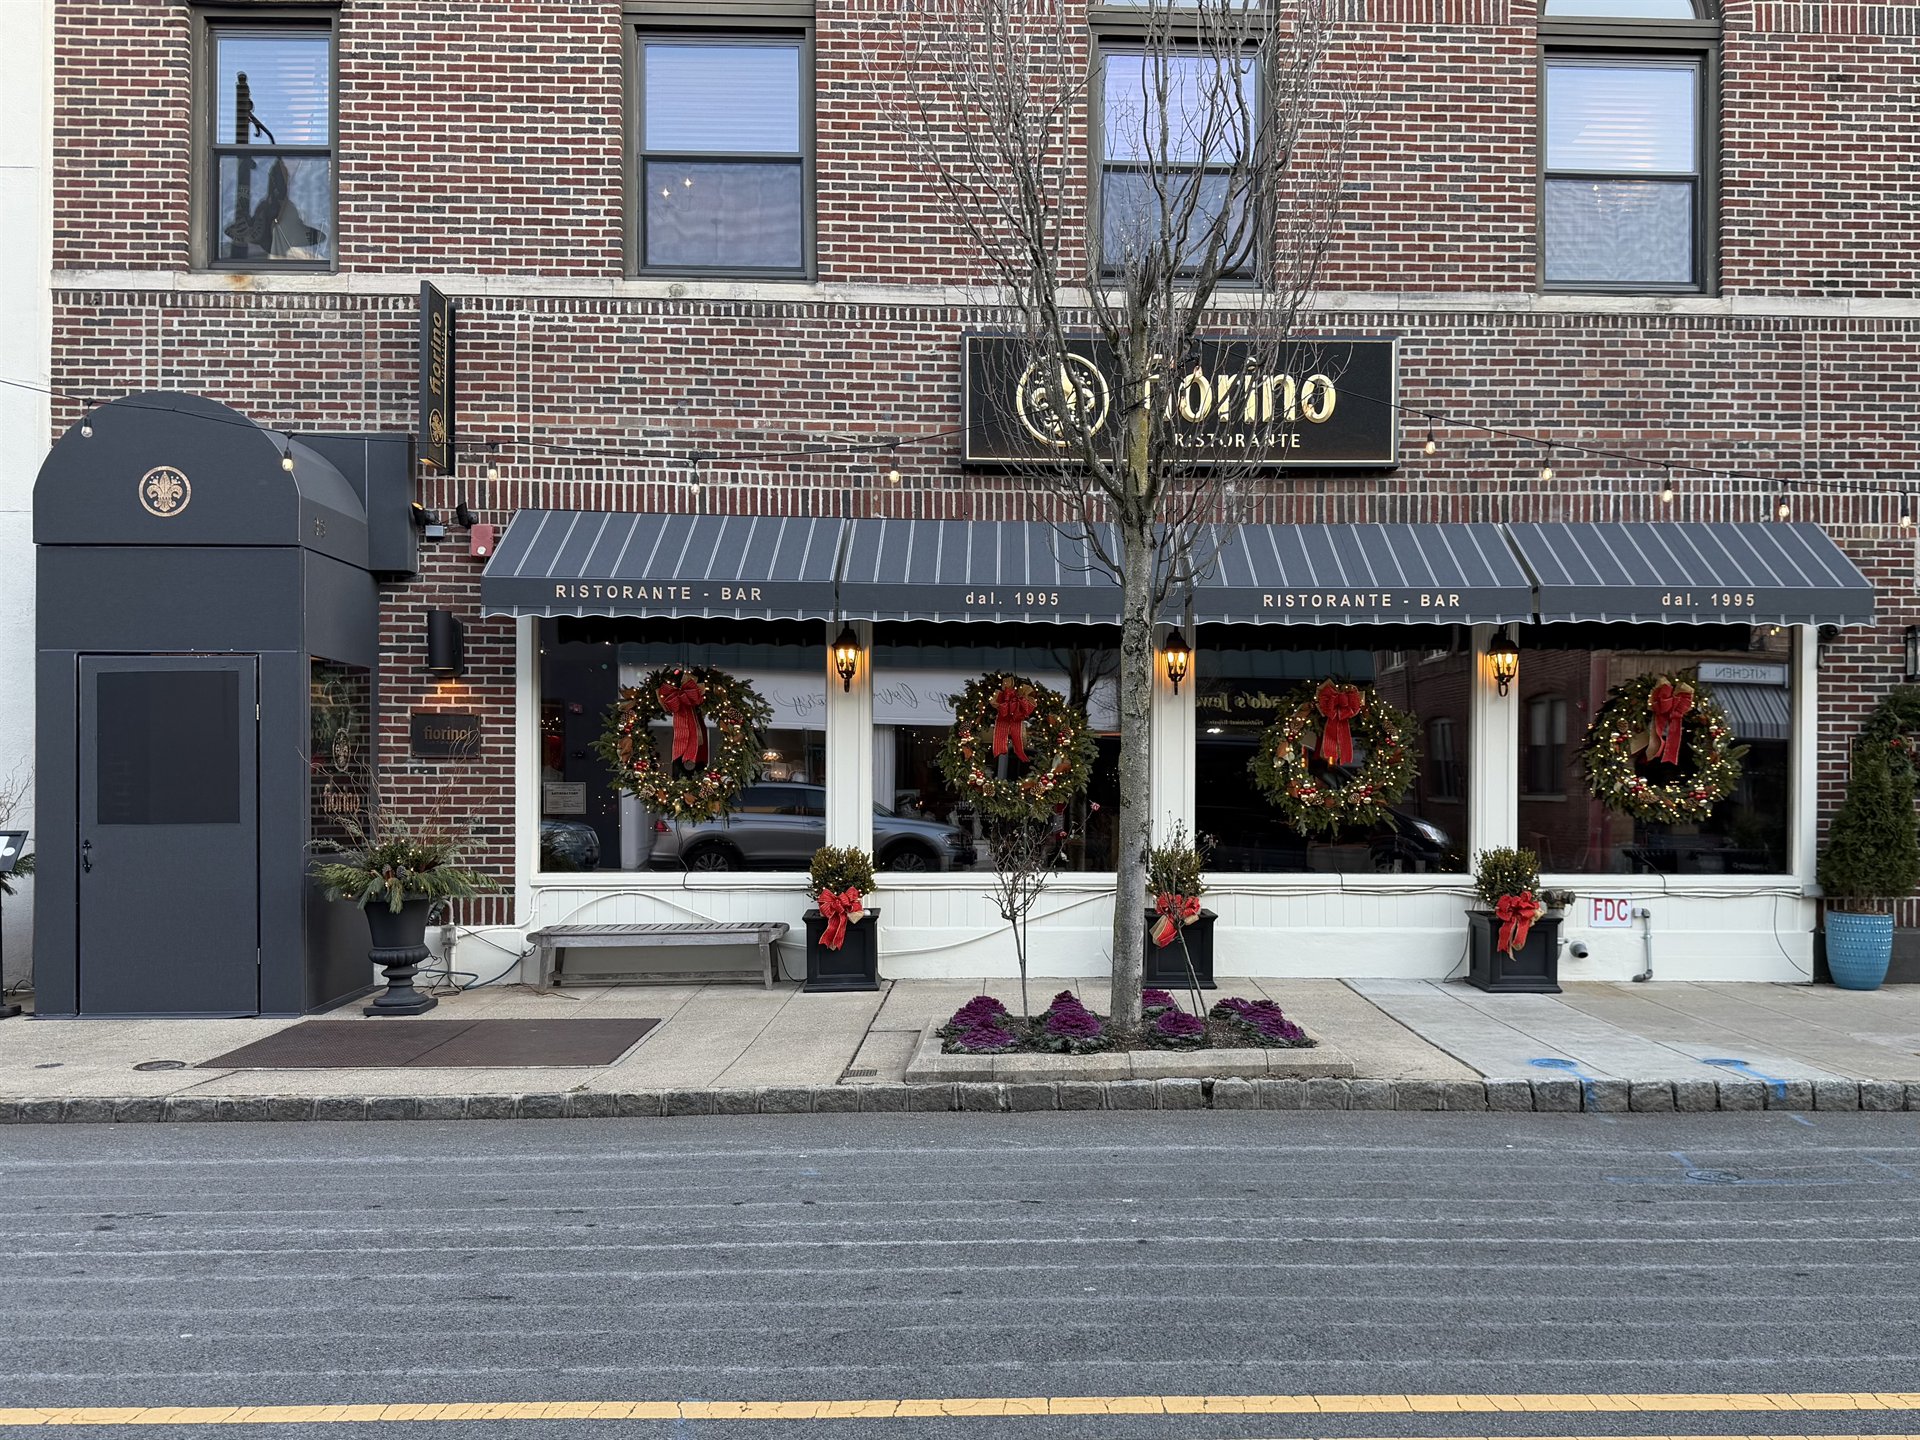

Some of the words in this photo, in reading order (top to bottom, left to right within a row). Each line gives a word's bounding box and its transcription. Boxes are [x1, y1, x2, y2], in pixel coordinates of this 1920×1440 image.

[429, 311, 442, 396] fiorino
[1174, 433, 1300, 448] RISTORANTE
[555, 584, 691, 600] RISTORANTE
[721, 587, 762, 601] BAR
[965, 591, 1003, 606] dal.
[1014, 592, 1059, 606] 1995
[1662, 592, 1699, 606] dal.
[1710, 593, 1755, 607] 1995
[1263, 594, 1392, 607] RISTORANTE
[1420, 594, 1460, 607] BAR
[424, 725, 467, 740] fiorino
[1593, 898, 1628, 921] FDC
